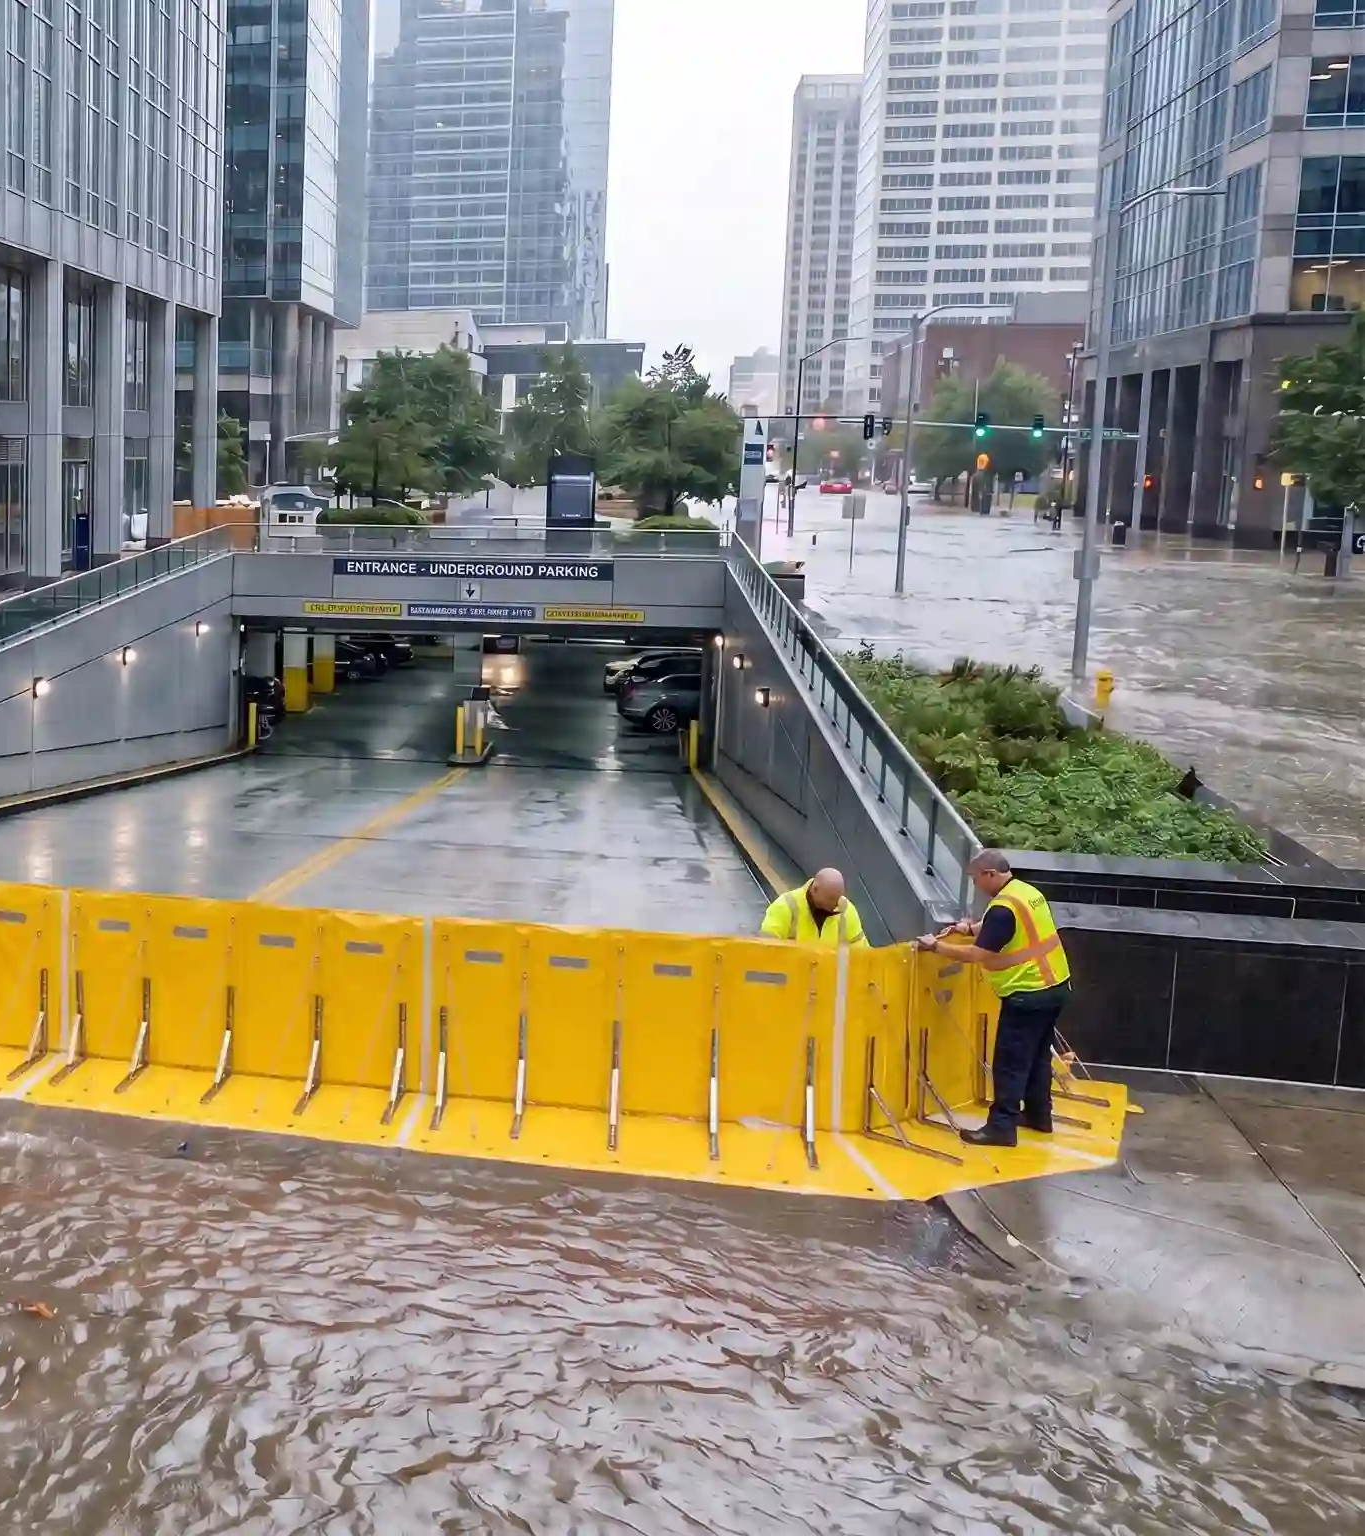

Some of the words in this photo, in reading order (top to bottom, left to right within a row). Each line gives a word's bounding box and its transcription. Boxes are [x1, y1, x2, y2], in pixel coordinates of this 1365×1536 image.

[346, 561, 417, 574] ENTRANCE
[429, 563, 534, 576] UNDERGROUND
[538, 565, 599, 578] PARKING
